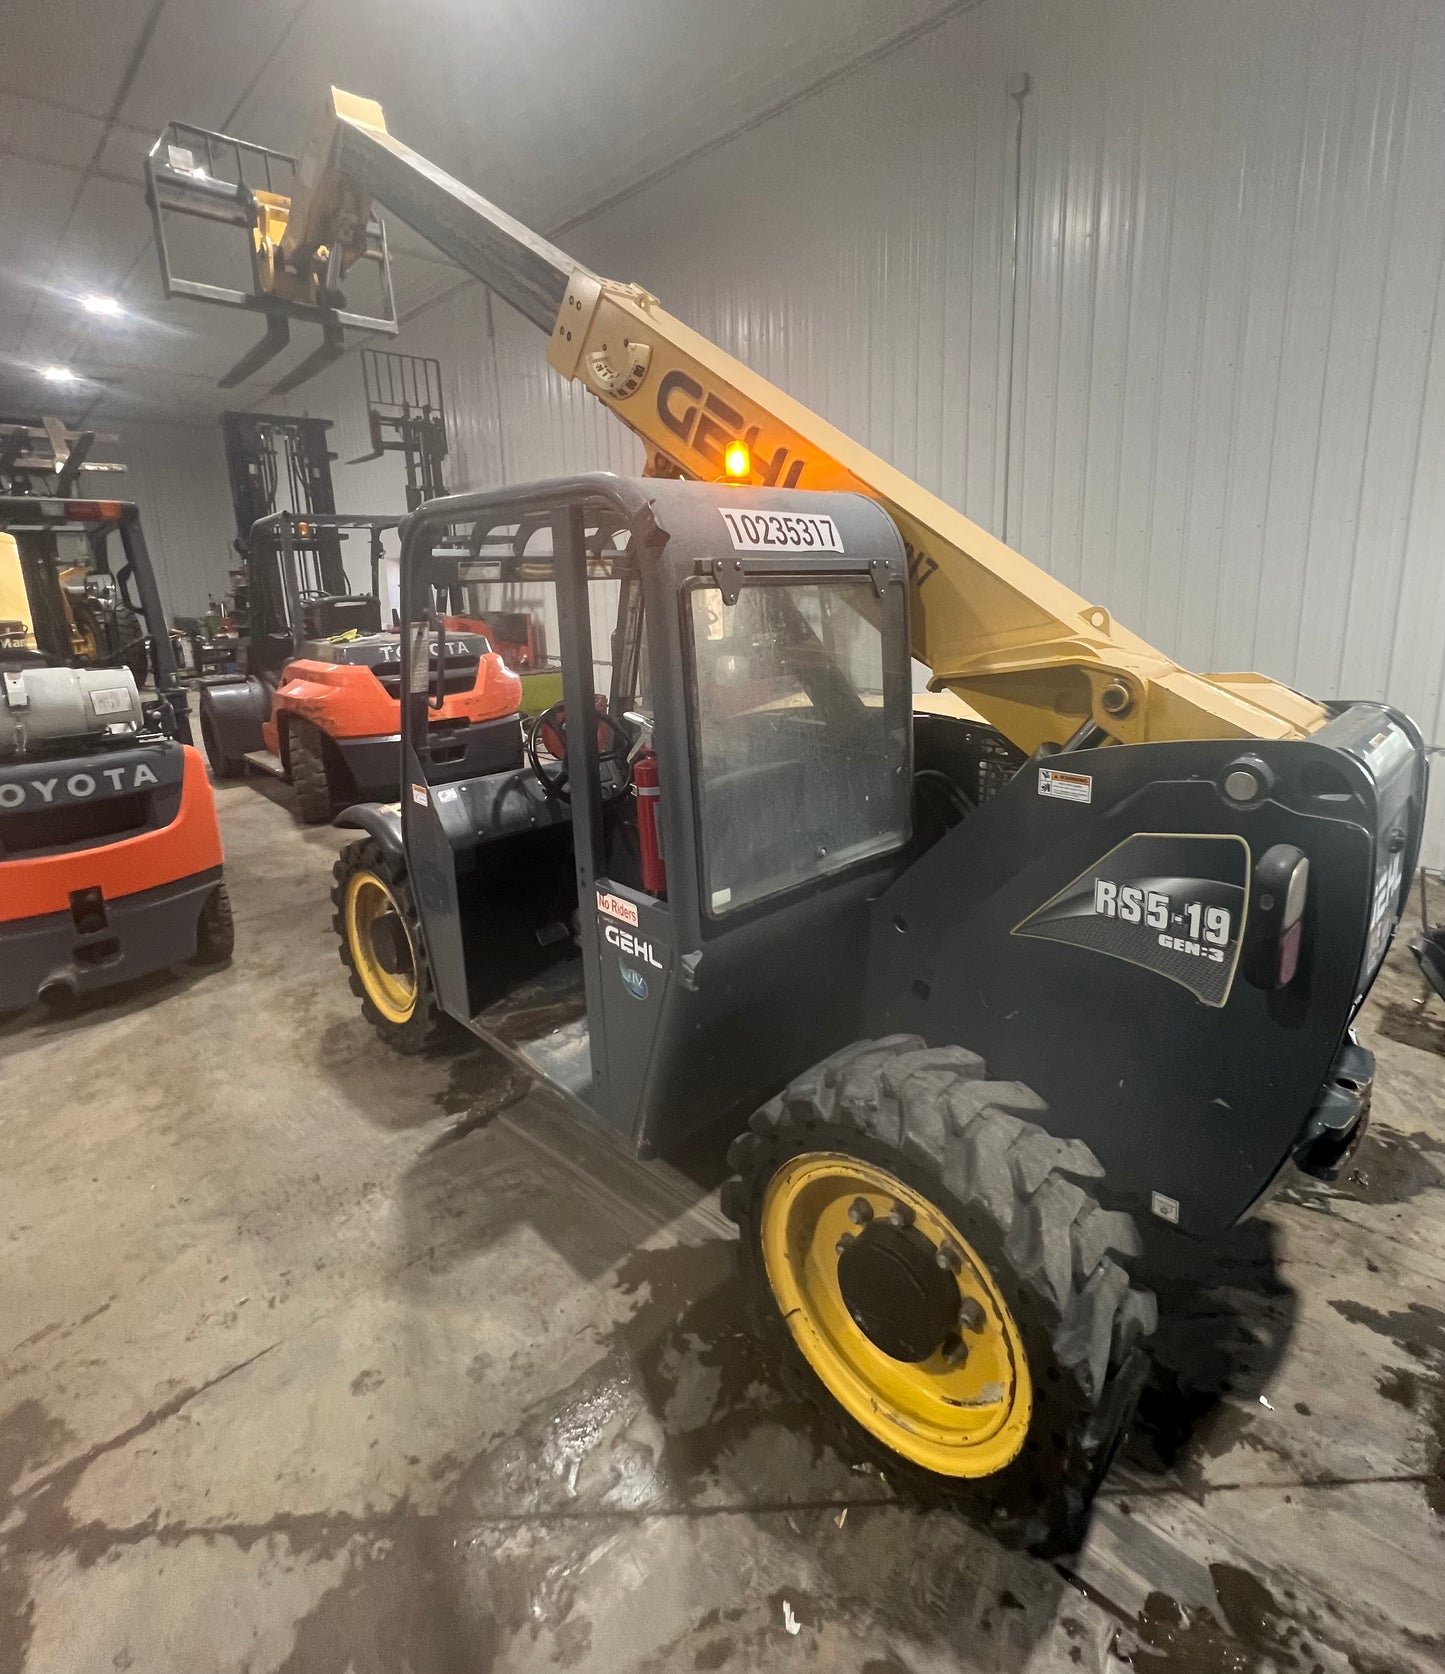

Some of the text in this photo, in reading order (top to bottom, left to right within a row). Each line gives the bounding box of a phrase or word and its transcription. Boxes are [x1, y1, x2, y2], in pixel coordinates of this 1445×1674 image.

[725, 514, 836, 546] 10235317
[379, 641, 470, 662] TOTA
[599, 895, 609, 910] No
[612, 899, 637, 922] Riders
[1096, 879, 1230, 946] RS5-19
[605, 925, 663, 969] GEHL
